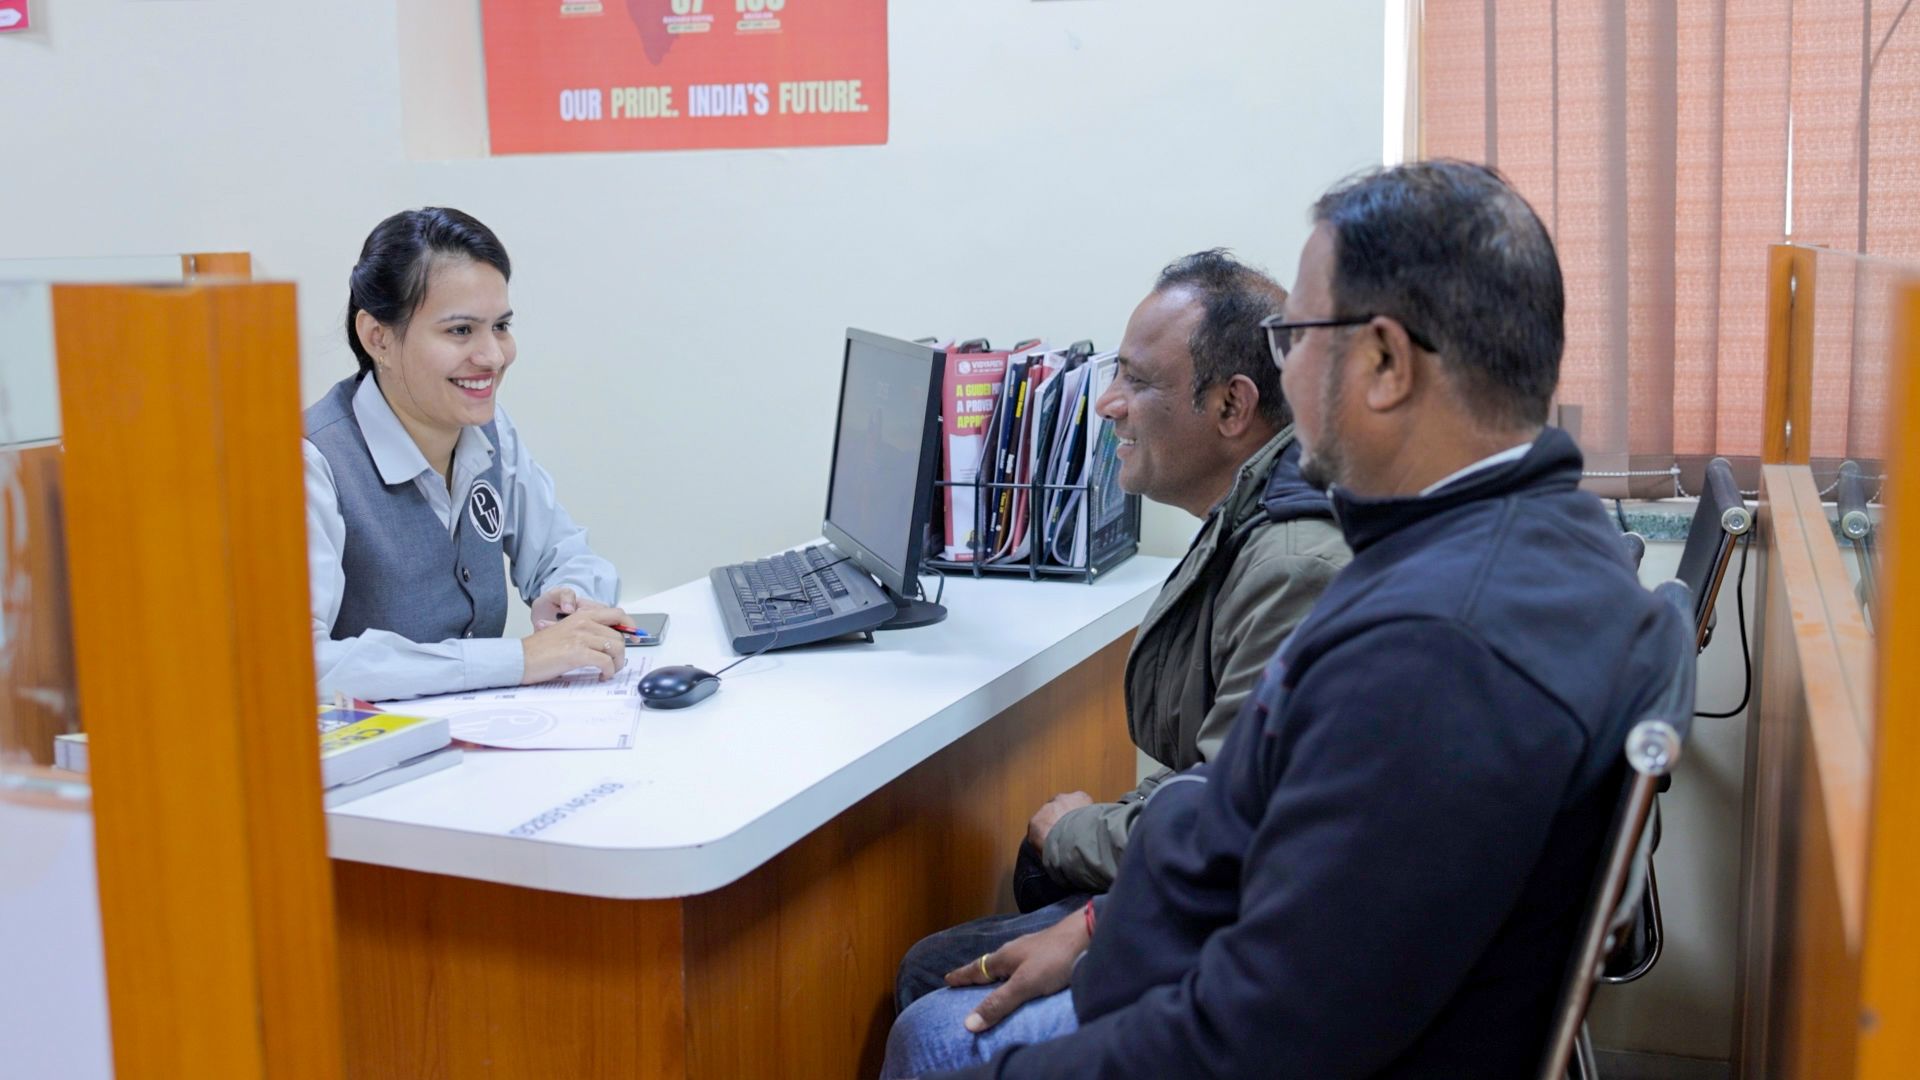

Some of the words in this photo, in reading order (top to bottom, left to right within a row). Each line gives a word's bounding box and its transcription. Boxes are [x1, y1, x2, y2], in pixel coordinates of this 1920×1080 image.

[560, 89, 602, 121] OUR
[610, 86, 680, 119] PRIDE.
[688, 82, 769, 117] INDIA'S
[779, 79, 869, 113] FUTURE.
